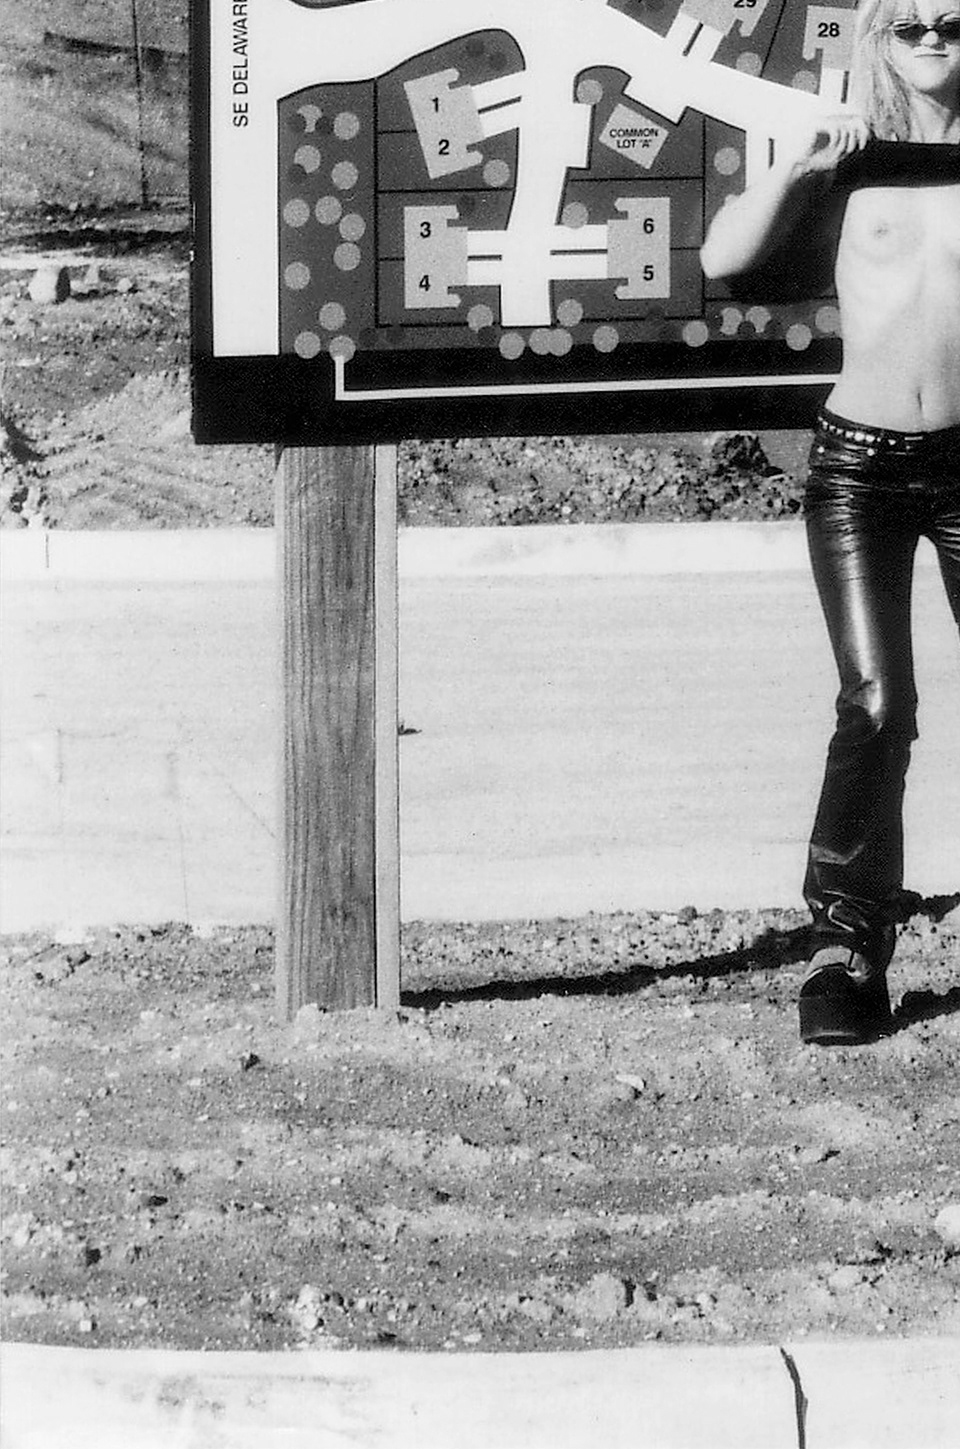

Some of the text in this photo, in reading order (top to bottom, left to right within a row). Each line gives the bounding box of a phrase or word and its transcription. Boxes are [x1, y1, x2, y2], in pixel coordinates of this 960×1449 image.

[817, 22, 841, 38] 28
[431, 97, 439, 113] 1
[233, 102, 249, 127] SE
[609, 127, 659, 139] COMMON
[438, 138, 450, 156] 2
[616, 138, 637, 149] LOT
[419, 221, 432, 239] 3
[643, 217, 655, 235] 6
[642, 264, 654, 282] 5
[418, 274, 431, 292] 4
